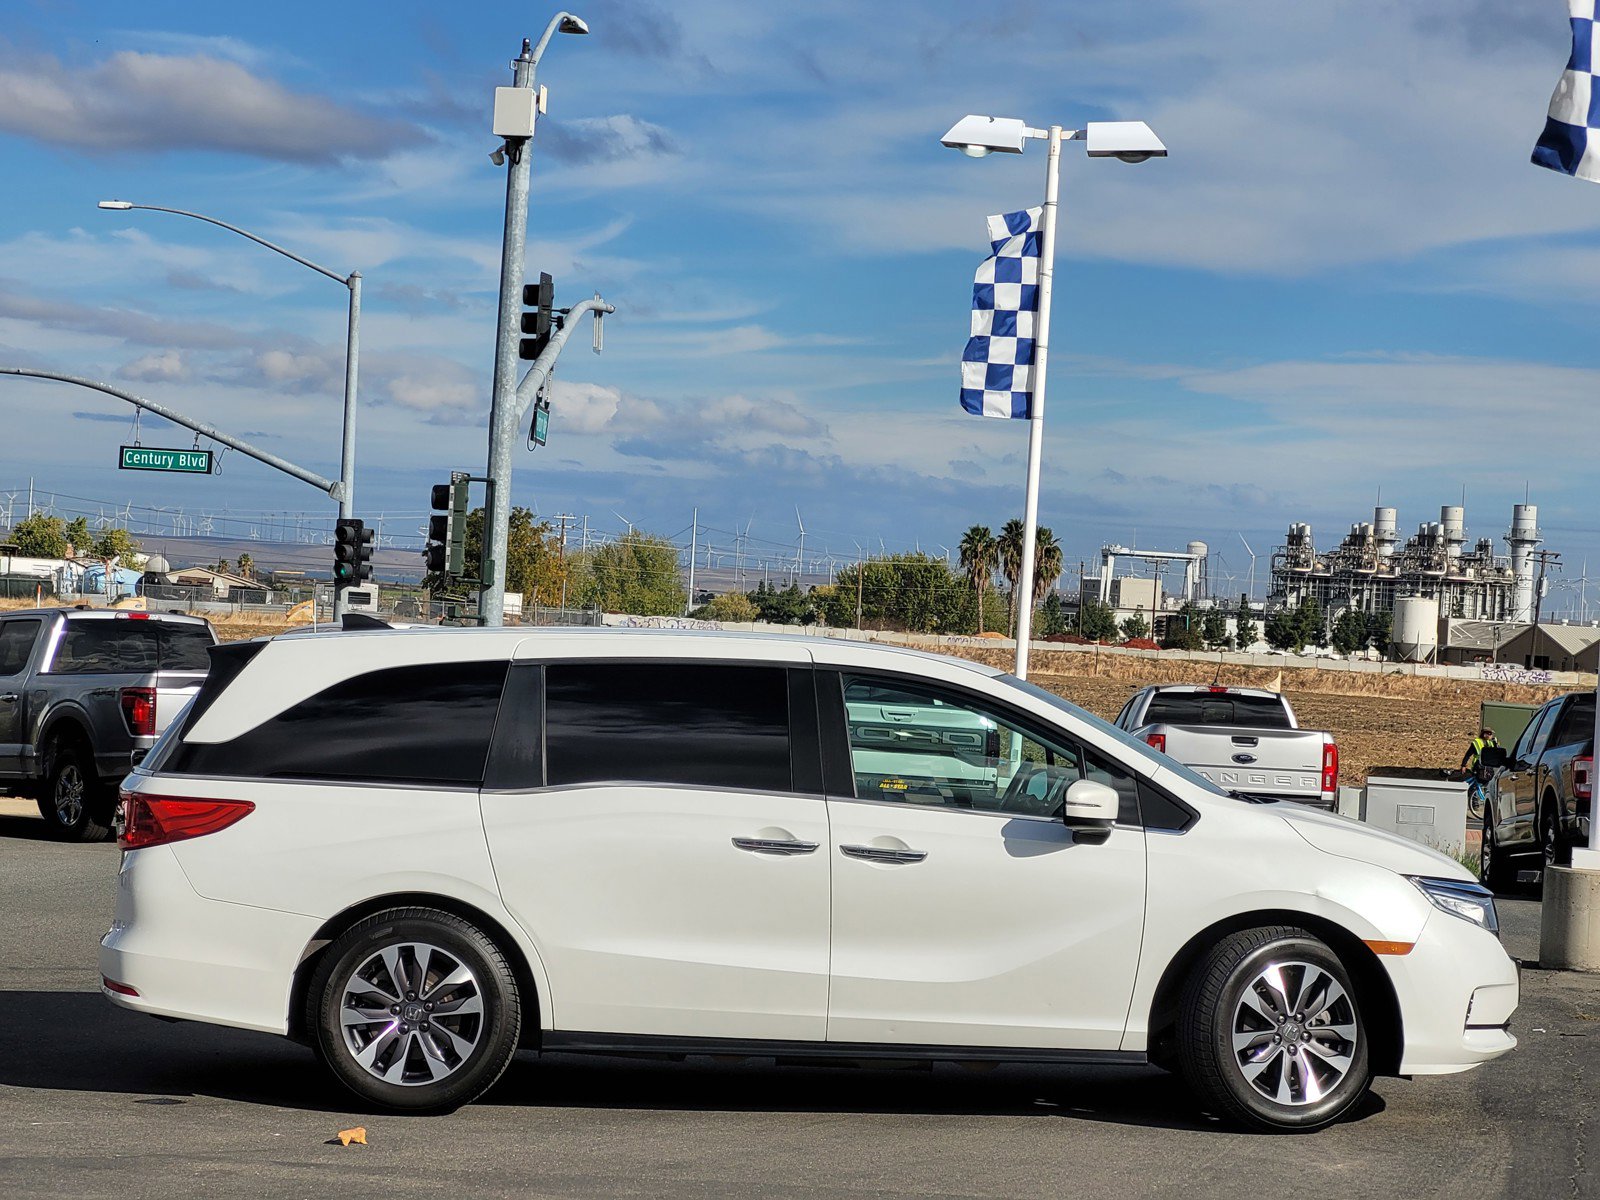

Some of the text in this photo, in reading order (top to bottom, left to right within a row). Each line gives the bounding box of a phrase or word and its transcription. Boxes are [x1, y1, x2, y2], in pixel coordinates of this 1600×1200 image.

[125, 451, 206, 469] Century Blvd
[1199, 771, 1318, 787] ANGER
